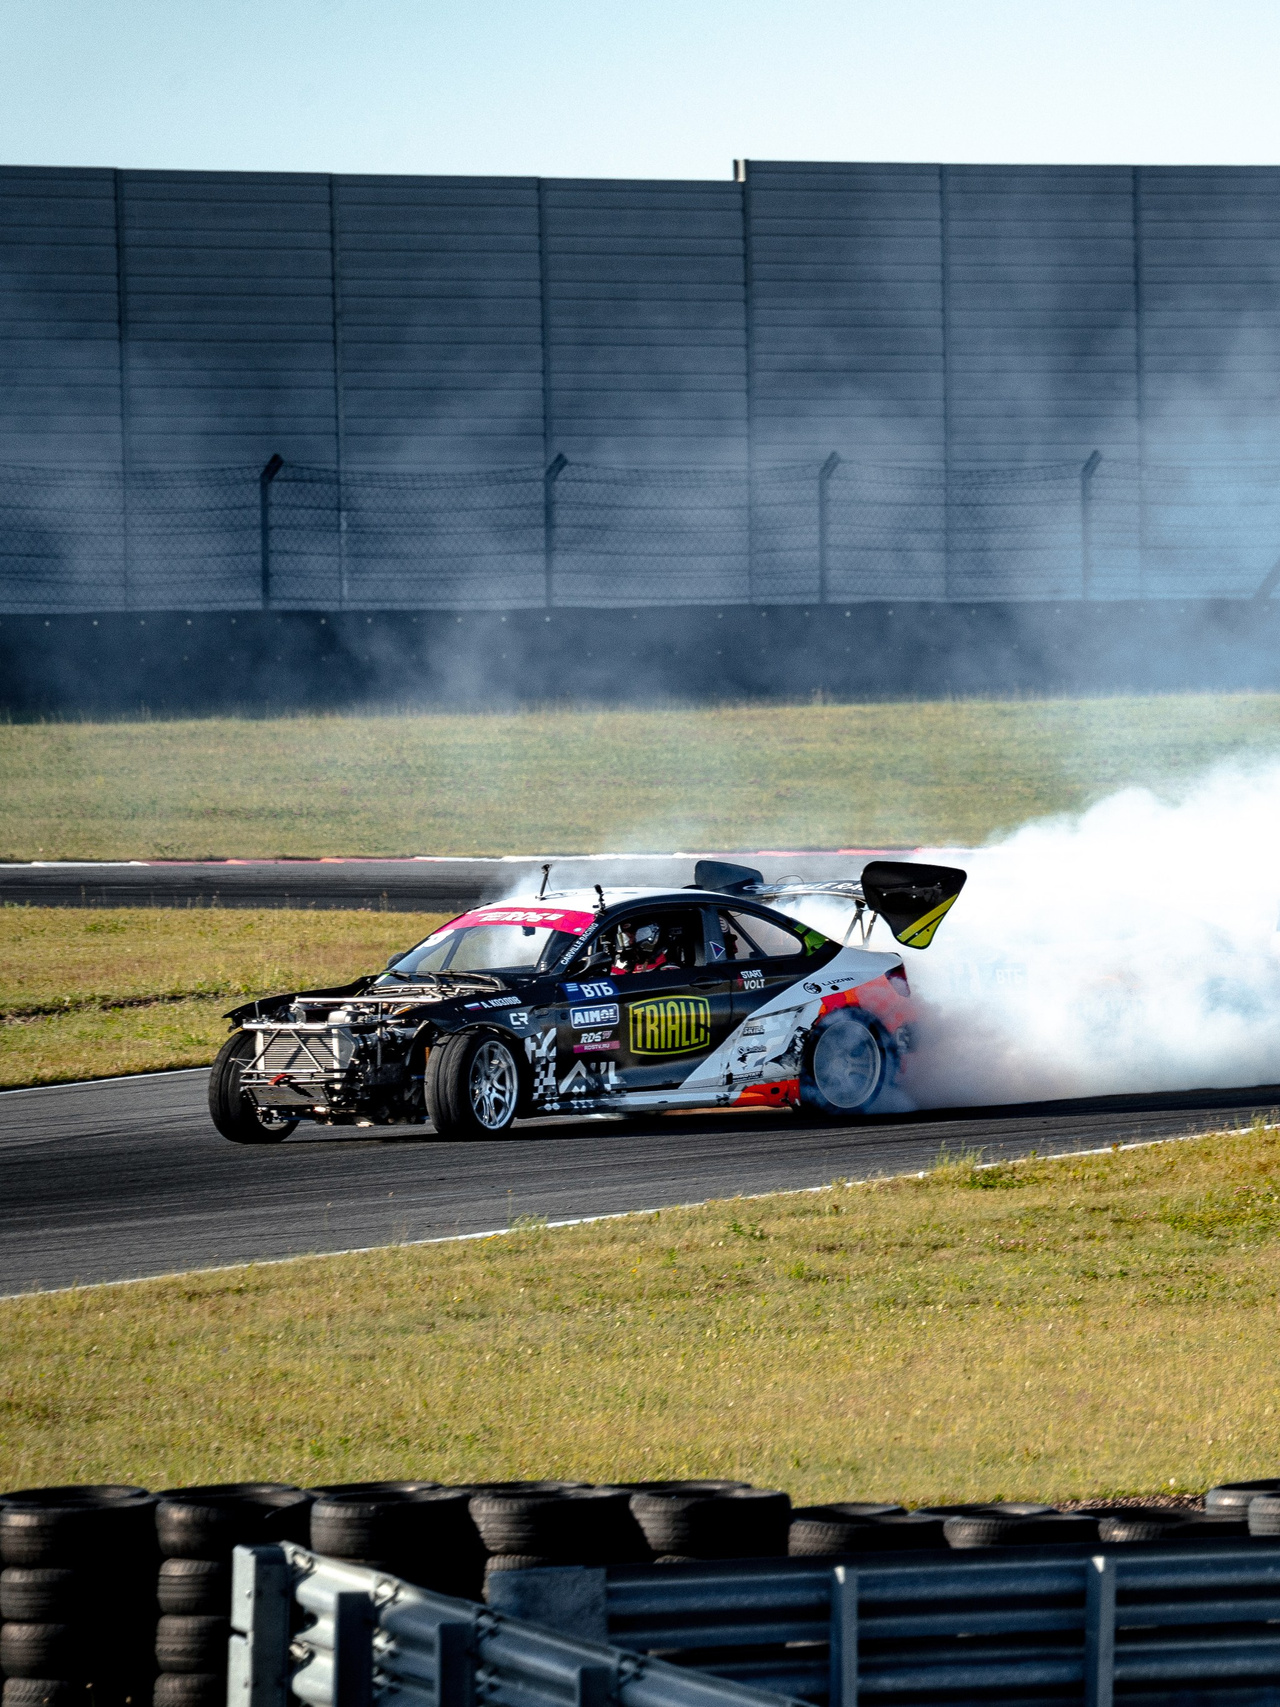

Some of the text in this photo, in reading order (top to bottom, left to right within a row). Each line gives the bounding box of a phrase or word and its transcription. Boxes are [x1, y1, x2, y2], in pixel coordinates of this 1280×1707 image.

[560, 923, 599, 965] CARVILLE RACING
[740, 969, 763, 979] START
[579, 982, 614, 998] ВТБ
[743, 979, 765, 990] VOLT
[574, 1009, 617, 1025] AIMOL
[633, 1001, 706, 1049] TRIALLI
[580, 1031, 603, 1044] RDS
